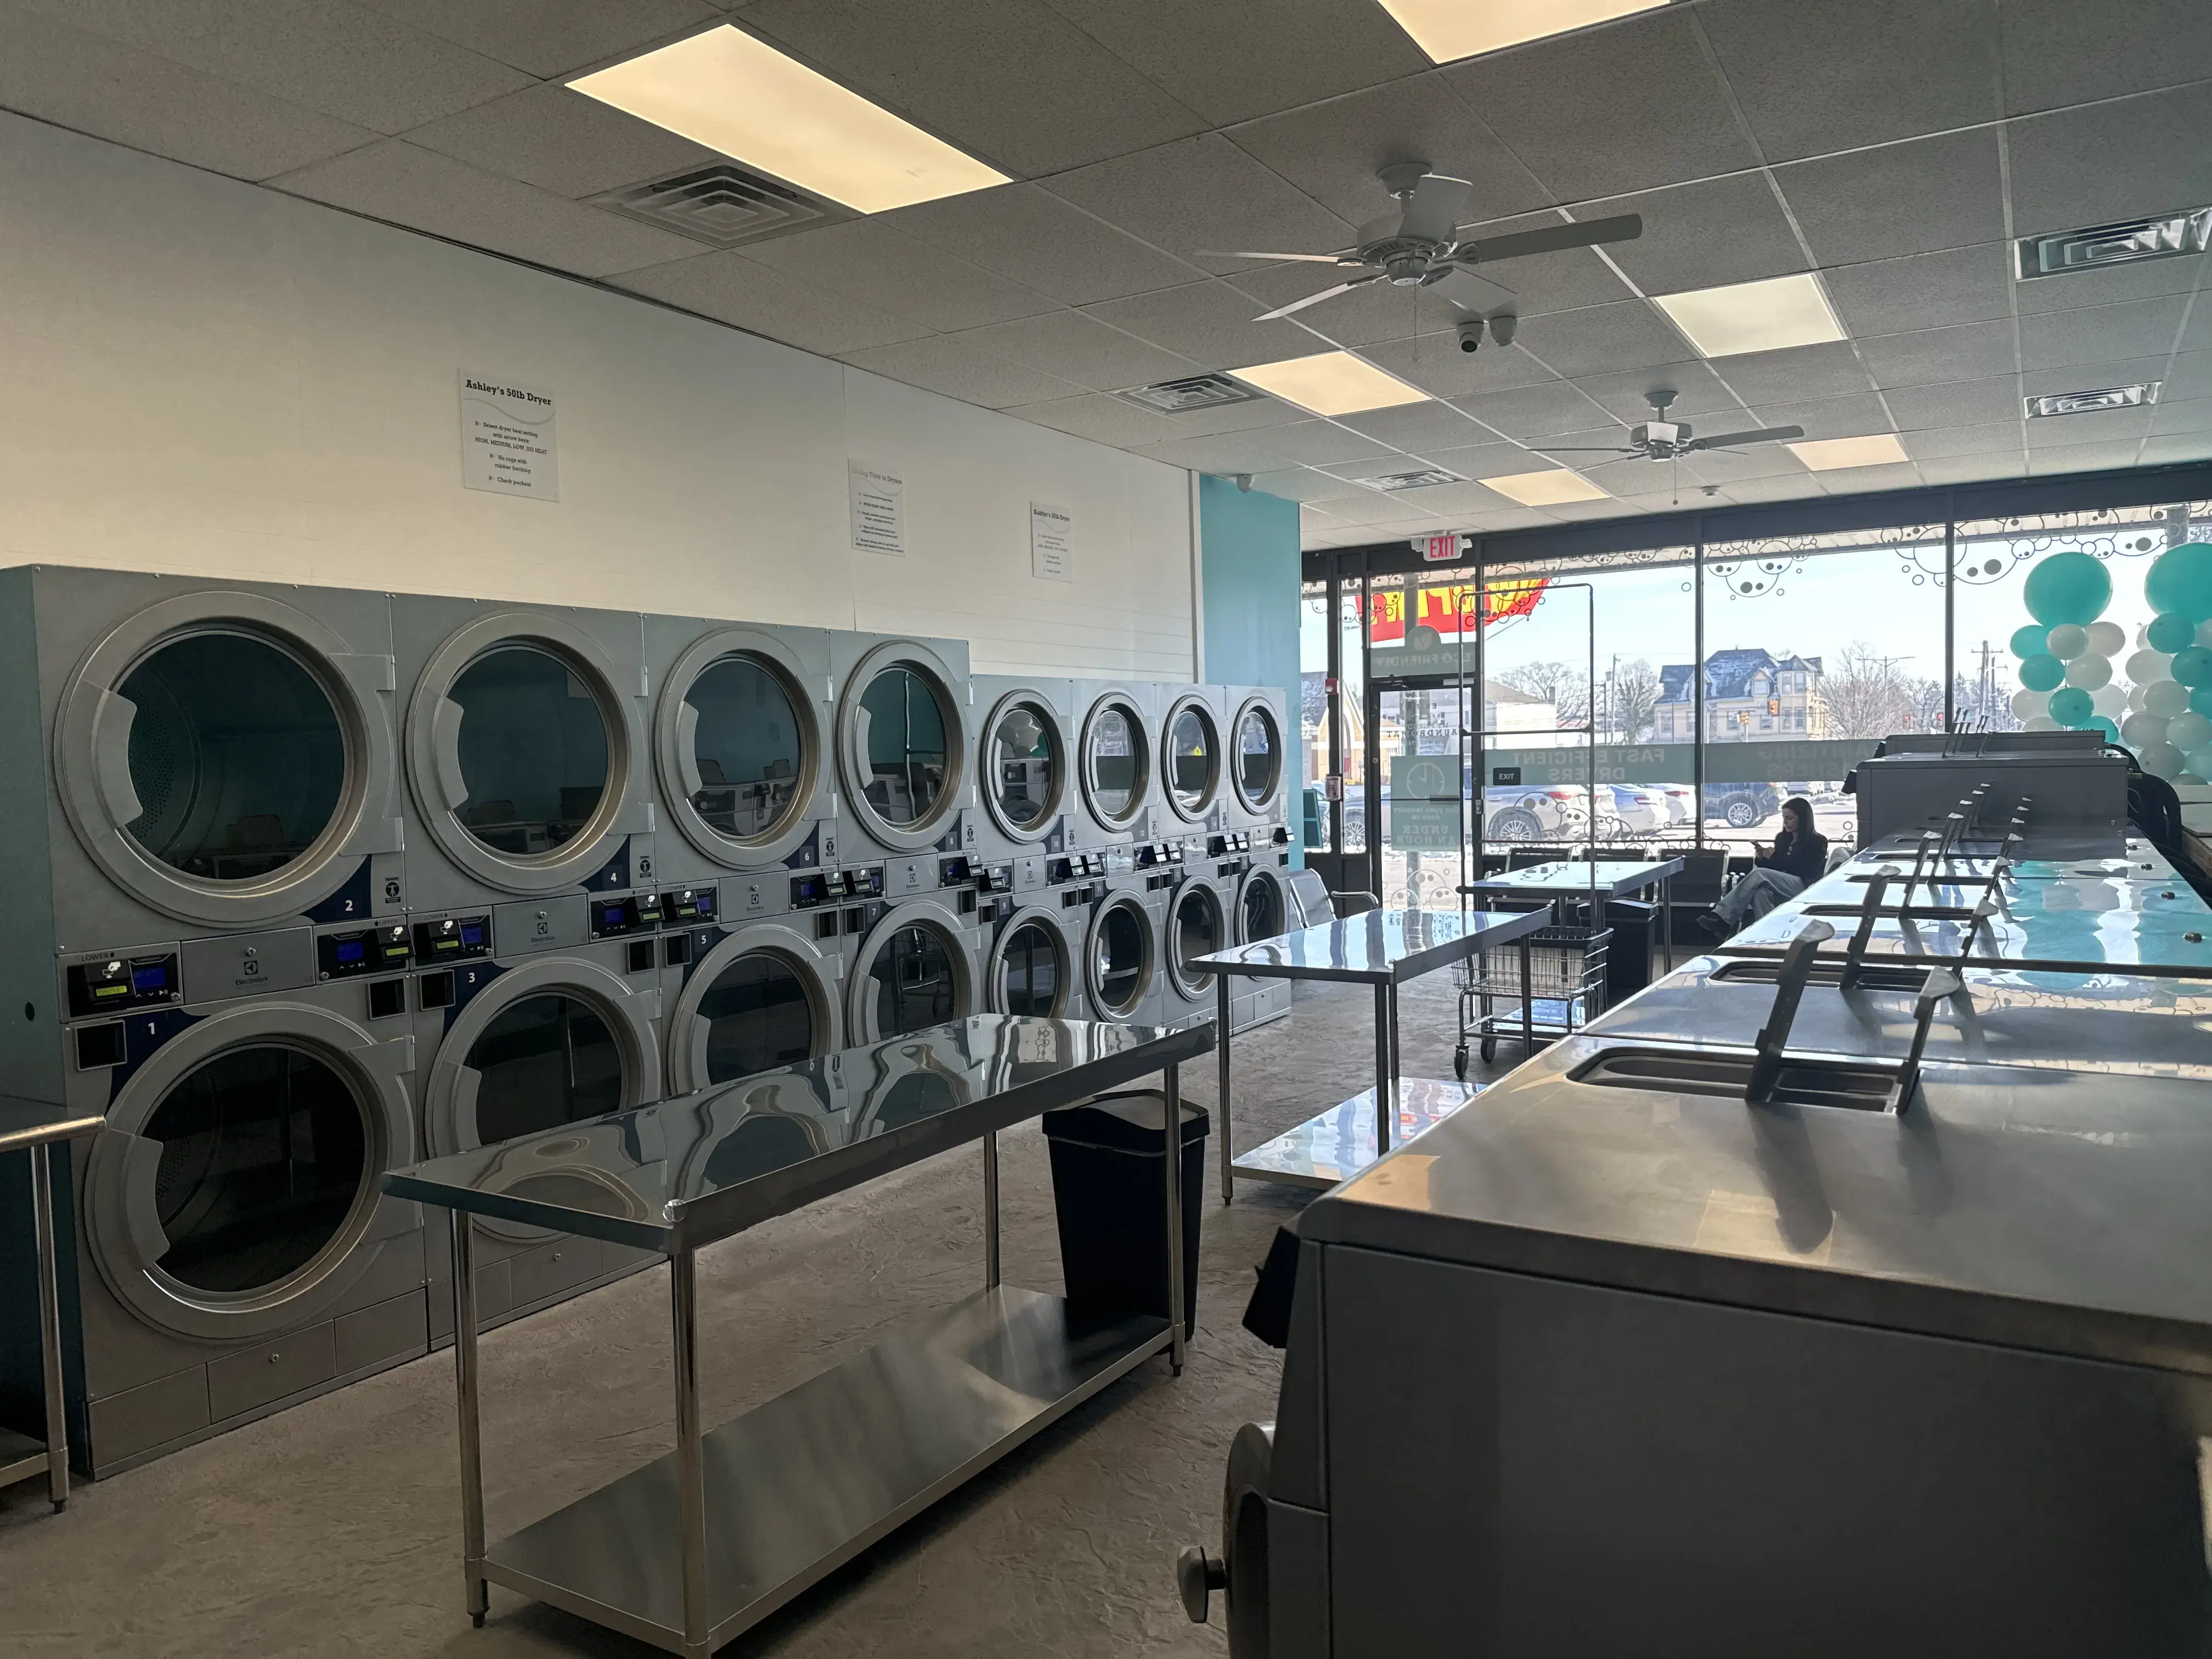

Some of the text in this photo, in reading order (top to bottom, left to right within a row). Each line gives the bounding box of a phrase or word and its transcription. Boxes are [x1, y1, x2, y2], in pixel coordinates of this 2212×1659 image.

[466, 380, 551, 406] Ashley's 50lb Dryer
[483, 422, 498, 430] Select
[498, 425, 512, 433] dryer
[512, 466, 531, 474] backing
[513, 479, 532, 487] pockets
[887, 476, 902, 485] Dryers
[1430, 535, 1456, 558] EXIT
[1499, 772, 1514, 781] EXIT
[949, 837, 954, 845] 8
[1053, 839, 1059, 848] 10
[804, 852, 810, 861] 6
[610, 873, 617, 882] 4
[345, 900, 353, 912] 2
[425, 913, 444, 921] LOWER
[872, 908, 876, 917] 7
[379, 918, 399, 927] UPPER
[701, 934, 707, 944] 5
[81, 952, 109, 962] LOWER
[235, 975, 268, 986] Electrolux
[469, 972, 475, 983] 3
[148, 1022, 156, 1035] 1
